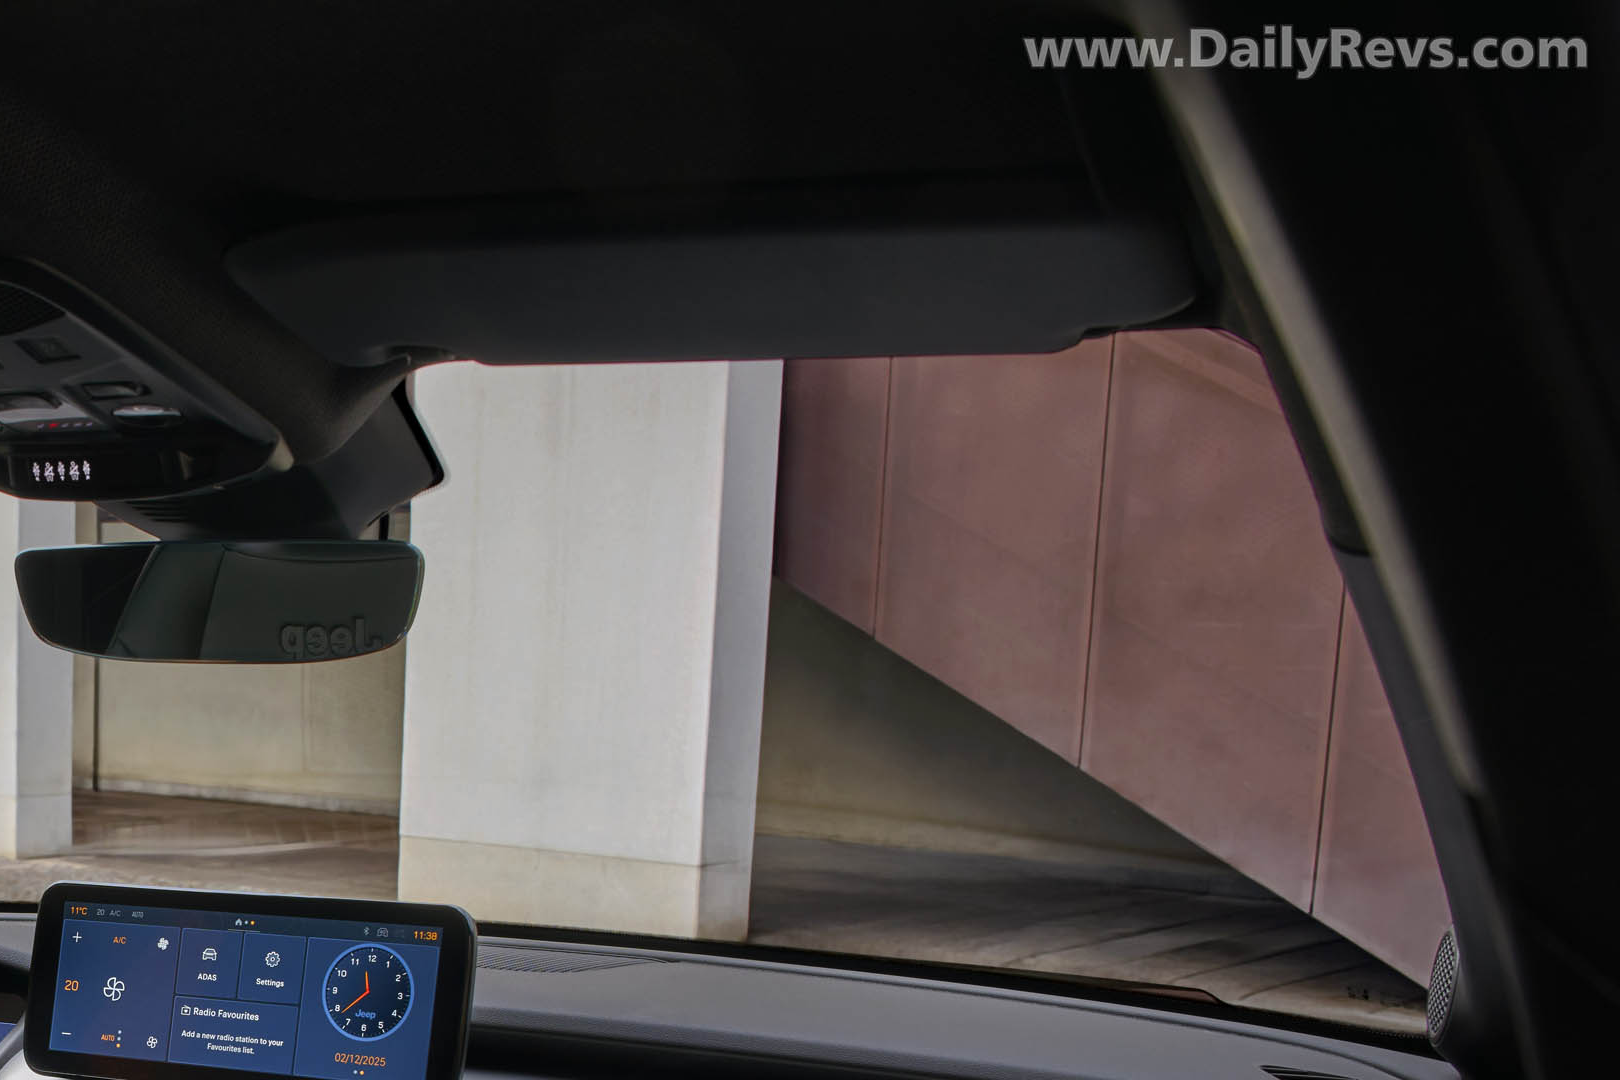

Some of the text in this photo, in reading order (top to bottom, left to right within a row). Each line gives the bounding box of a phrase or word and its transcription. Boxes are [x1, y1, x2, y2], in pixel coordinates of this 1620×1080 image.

[113, 936, 127, 944] A/C
[413, 930, 438, 941] 11:38
[368, 954, 377, 963] 12
[197, 972, 217, 981] ADAS
[337, 969, 347, 978] 10
[395, 974, 401, 982] 2
[64, 979, 79, 991] 20
[255, 977, 285, 988] Settings
[332, 986, 338, 994] 9
[397, 992, 403, 1000] 3
[334, 1004, 340, 1012] 8
[193, 1007, 260, 1021] Radio Favourites
[355, 1009, 376, 1020] Jeep
[391, 1009, 397, 1017] 4
[345, 1018, 351, 1026] 7
[378, 1021, 384, 1029] 5
[361, 1023, 367, 1032] 6
[100, 1033, 115, 1042] AUTO
[181, 1029, 195, 1038] Add
[201, 1032, 216, 1040] new
[216, 1033, 234, 1042] radio
[235, 1035, 258, 1044] station
[259, 1037, 268, 1046] to
[268, 1039, 284, 1047] your
[207, 1042, 255, 1055] Favourites list.
[334, 1052, 386, 1067] 02/12/2025
